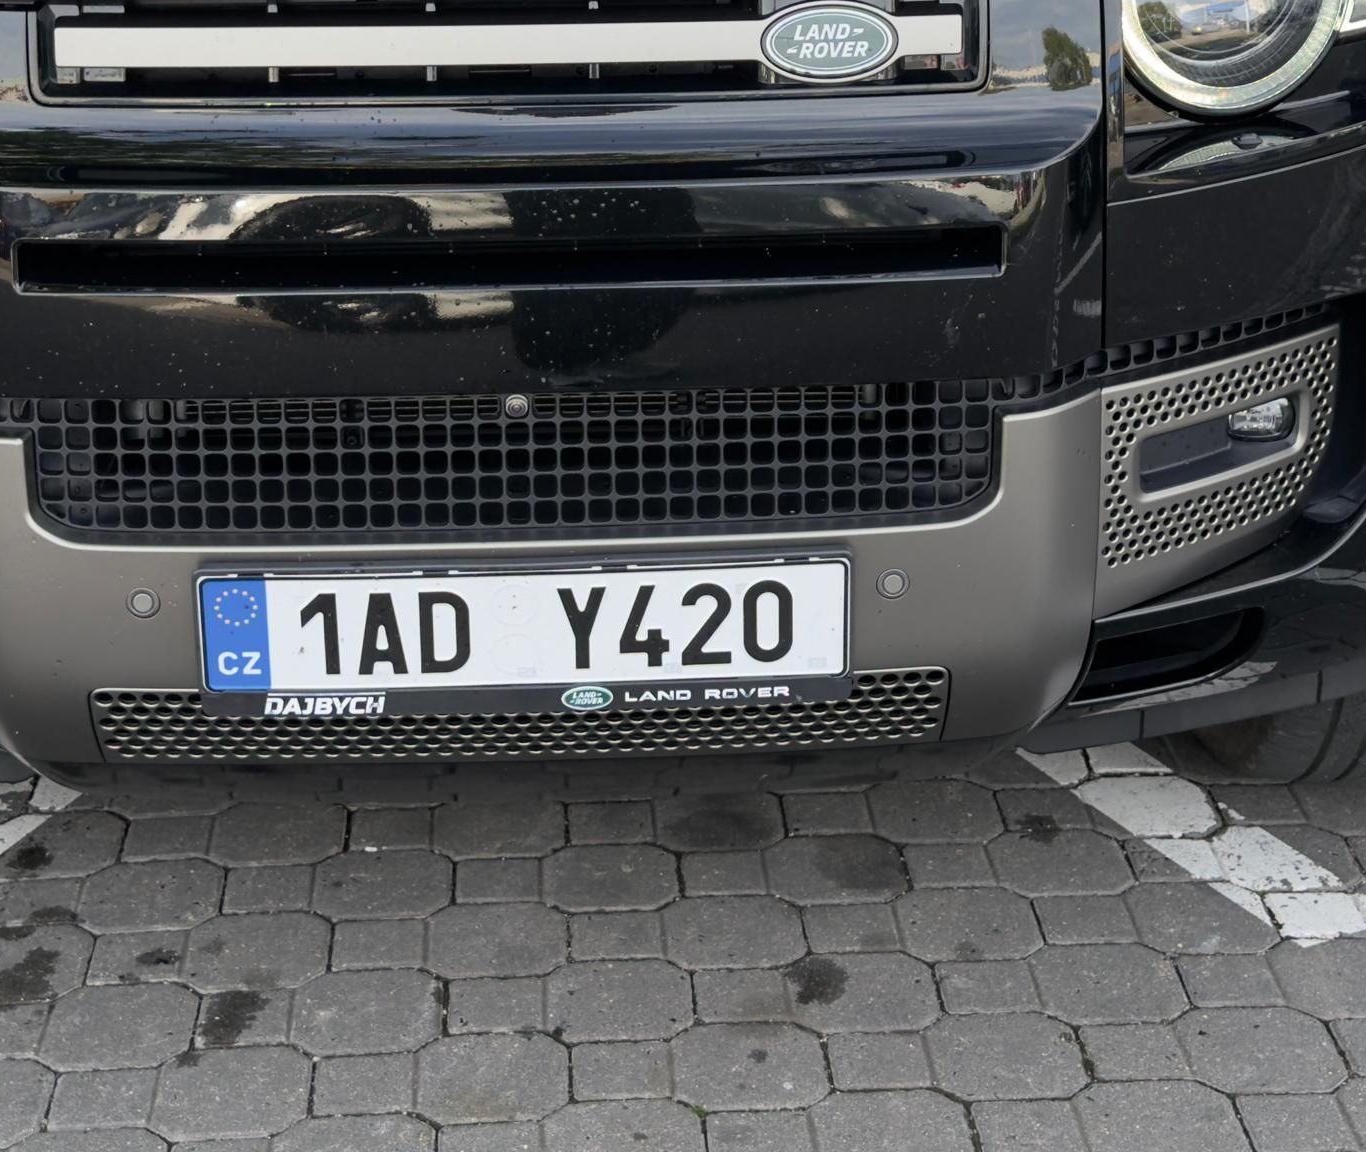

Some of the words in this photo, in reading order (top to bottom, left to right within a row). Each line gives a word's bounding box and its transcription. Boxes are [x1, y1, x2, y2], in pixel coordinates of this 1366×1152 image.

[300, 591, 472, 676] 1AD
[556, 579, 793, 669] Y420
[217, 651, 262, 676] CZ
[624, 688, 692, 702] LAND
[704, 686, 790, 700] ROVER
[264, 696, 385, 715] DAJBYCH
